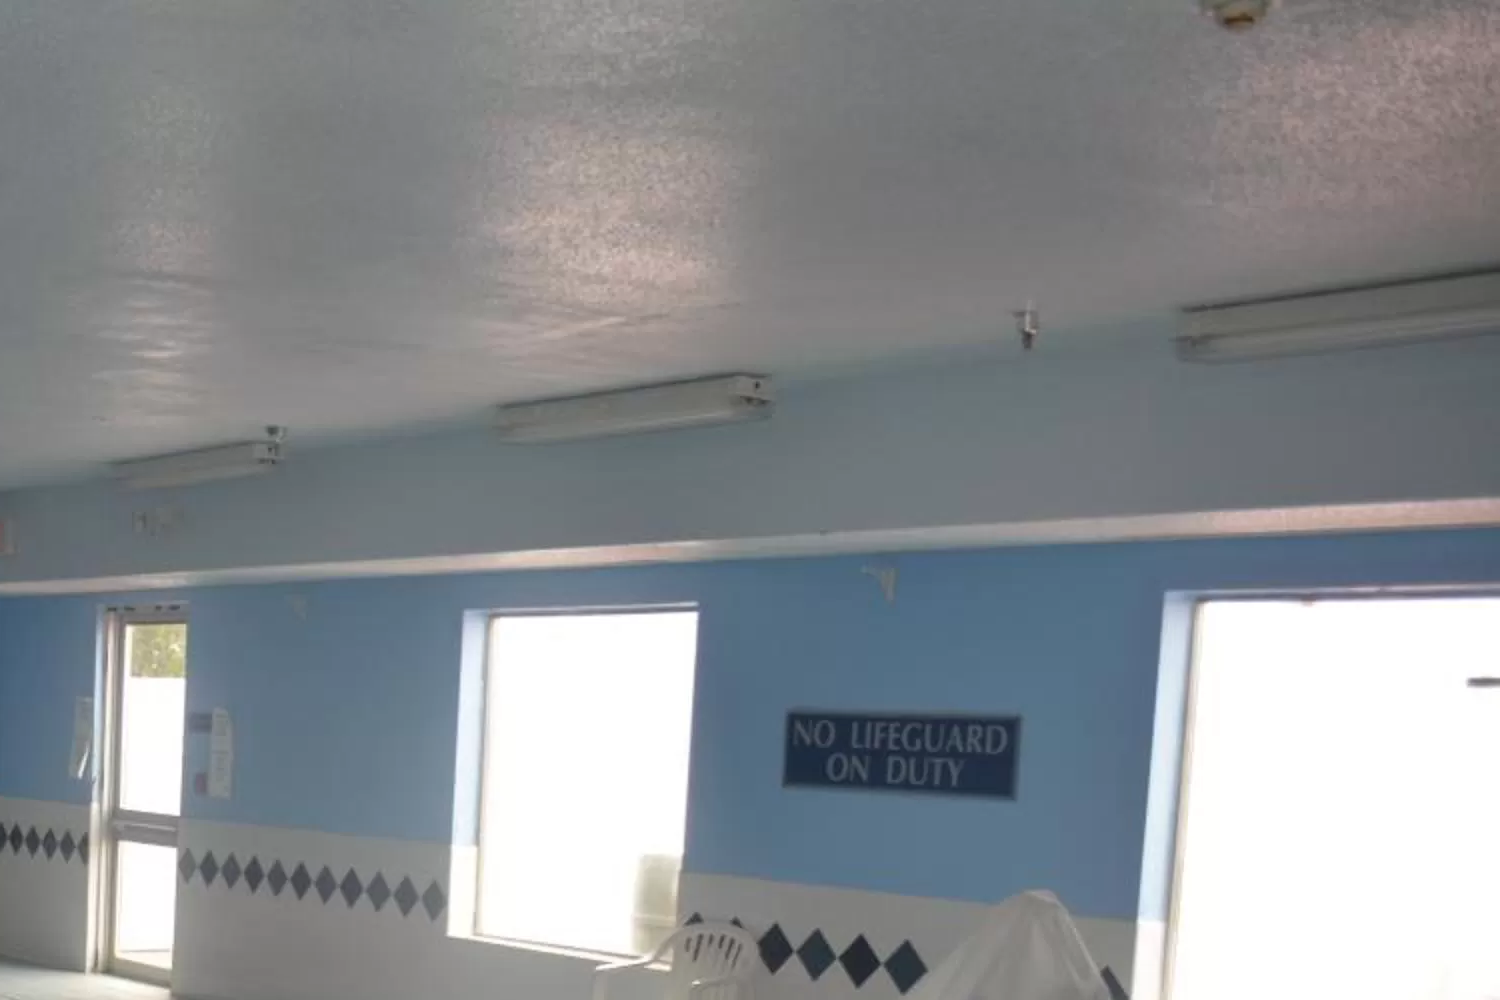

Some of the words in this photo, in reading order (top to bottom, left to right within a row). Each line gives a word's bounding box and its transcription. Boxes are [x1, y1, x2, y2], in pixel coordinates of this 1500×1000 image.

[793, 719, 836, 748] NO
[852, 721, 1008, 754] LIFEGUARD
[825, 752, 869, 783] ON
[886, 755, 967, 787] DUTY
